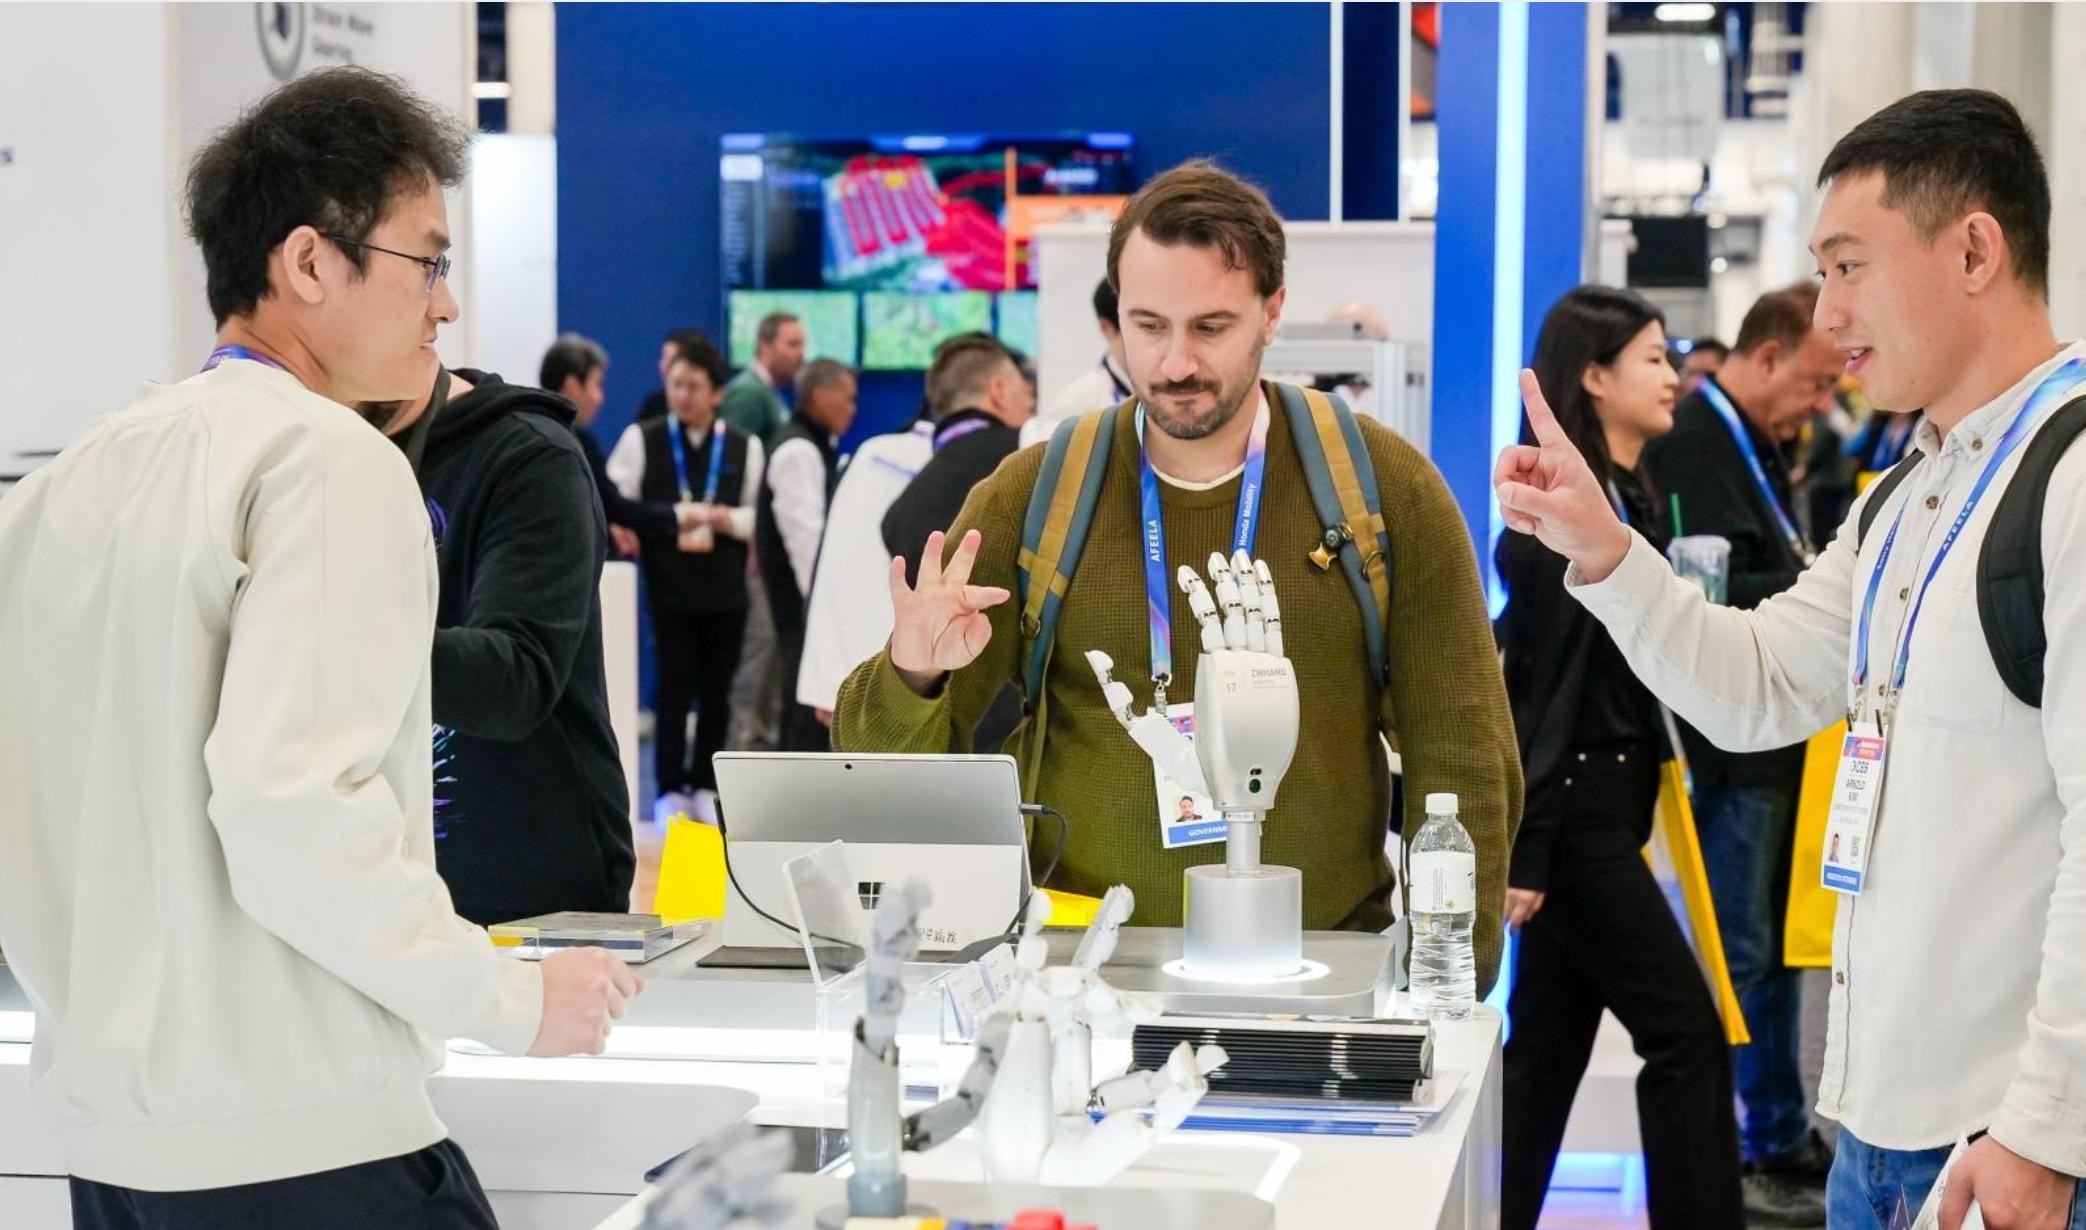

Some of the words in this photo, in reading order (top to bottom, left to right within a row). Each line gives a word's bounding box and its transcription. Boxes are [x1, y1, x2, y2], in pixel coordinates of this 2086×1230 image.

[1243, 483, 1257, 518] Mobility
[1148, 519, 1160, 562] AFEELA
[1240, 518, 1250, 546] Honda
[1942, 501, 1974, 551] AFEELA
[1226, 682, 1237, 693] 17
